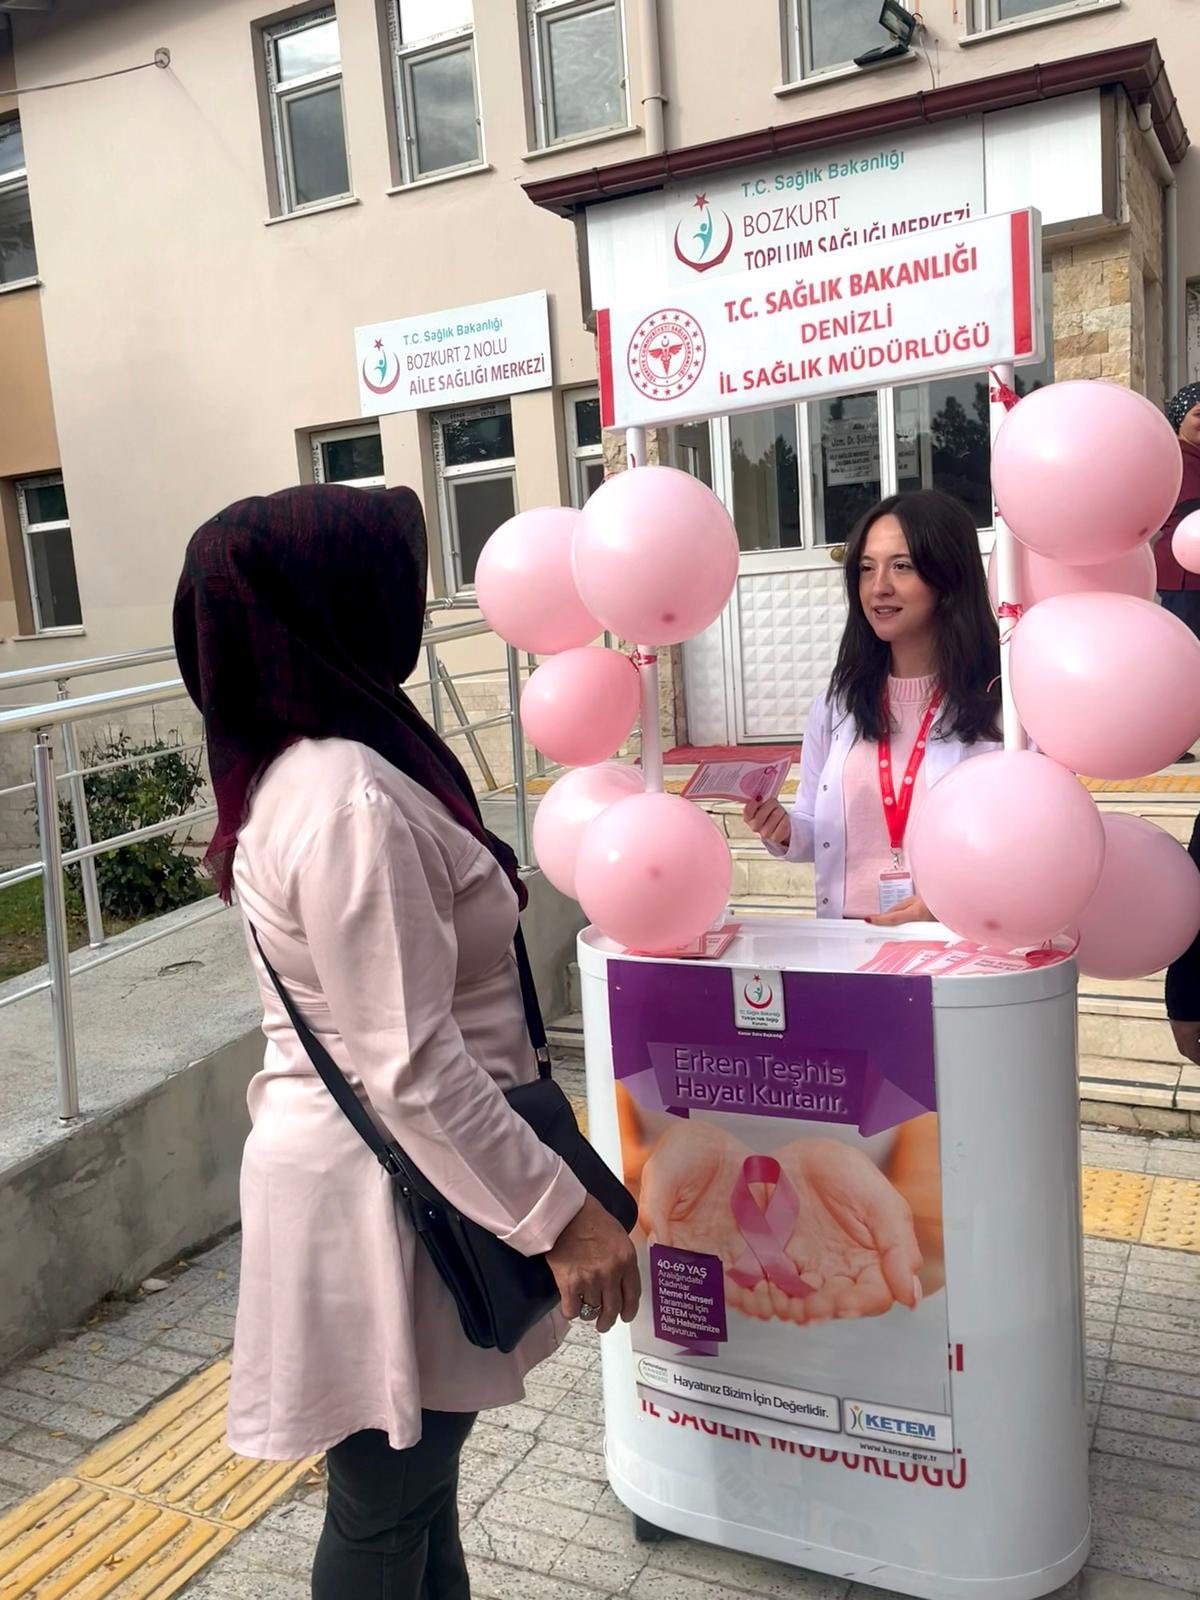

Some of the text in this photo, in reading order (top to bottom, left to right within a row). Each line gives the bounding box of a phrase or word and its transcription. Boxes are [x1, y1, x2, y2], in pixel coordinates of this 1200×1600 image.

[741, 150, 905, 198] T.C. Sağlık Bakanlığı
[743, 196, 840, 238] BOZKURT
[725, 242, 978, 323] T.C. SAĞLIK BAKANLIĞI
[403, 318, 503, 346] T.C. Sağlık Bakanlığı
[801, 302, 893, 344] DENİZLİ
[407, 337, 508, 371] BOZKURT 2 NOLU
[719, 321, 990, 395] İL SAĞLIK MÜDÜRLÜĞÜ
[409, 353, 545, 396] AİLE SAĞLIĞI MERKEZİ
[674, 1047, 847, 1087] Erken Teşhis
[676, 1076, 848, 1114] Hayat Kurtarır.
[657, 1259, 707, 1279] 40-69 YAŞ
[659, 1287, 683, 1299] Meme
[660, 1305, 688, 1318] KETEM
[674, 1374, 721, 1395] Hayatınız
[722, 1385, 752, 1401] Bizim
[753, 1389, 772, 1407] İçin
[774, 1398, 829, 1418] Değerlidir.
[865, 1414, 936, 1438] KETEM
[859, 1442, 937, 1462] www.kanser.gov.tr
